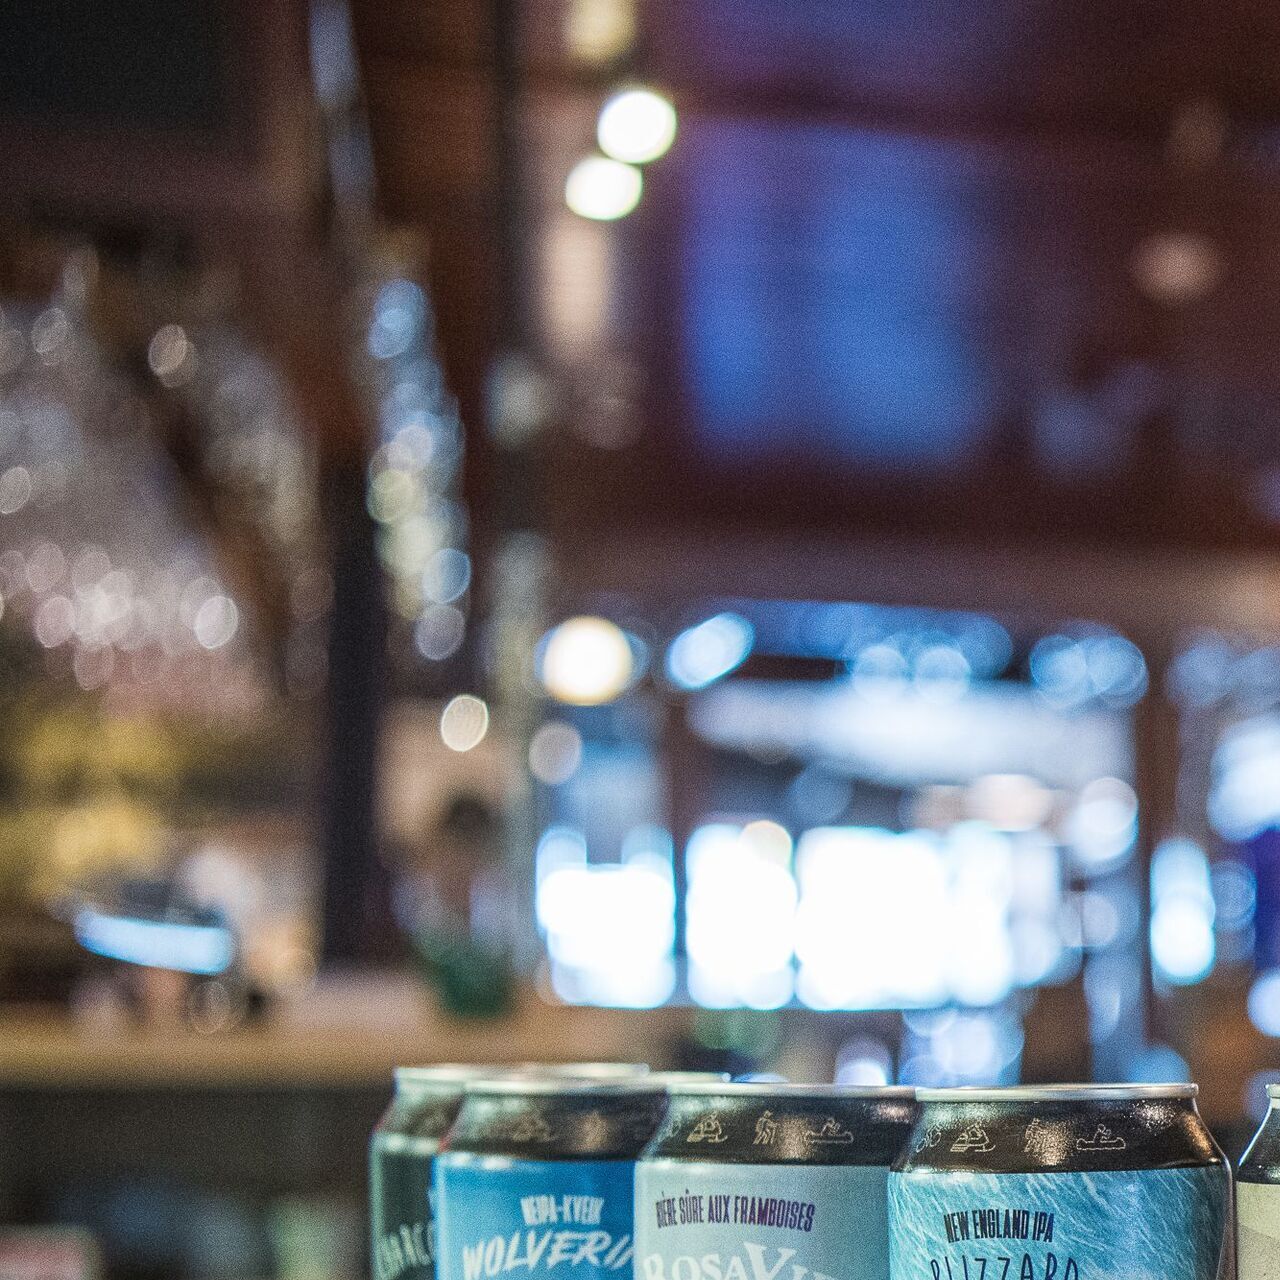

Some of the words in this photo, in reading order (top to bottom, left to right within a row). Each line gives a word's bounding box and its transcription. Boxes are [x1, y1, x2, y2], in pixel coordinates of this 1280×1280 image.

[679, 1188, 705, 1225] SÛRE
[707, 1194, 731, 1224] AUX
[734, 1195, 816, 1233] FRAMBOISES
[943, 1210, 970, 1243] NEW
[972, 1208, 1030, 1240] ENGLAND
[1032, 1210, 1055, 1243] IPA
